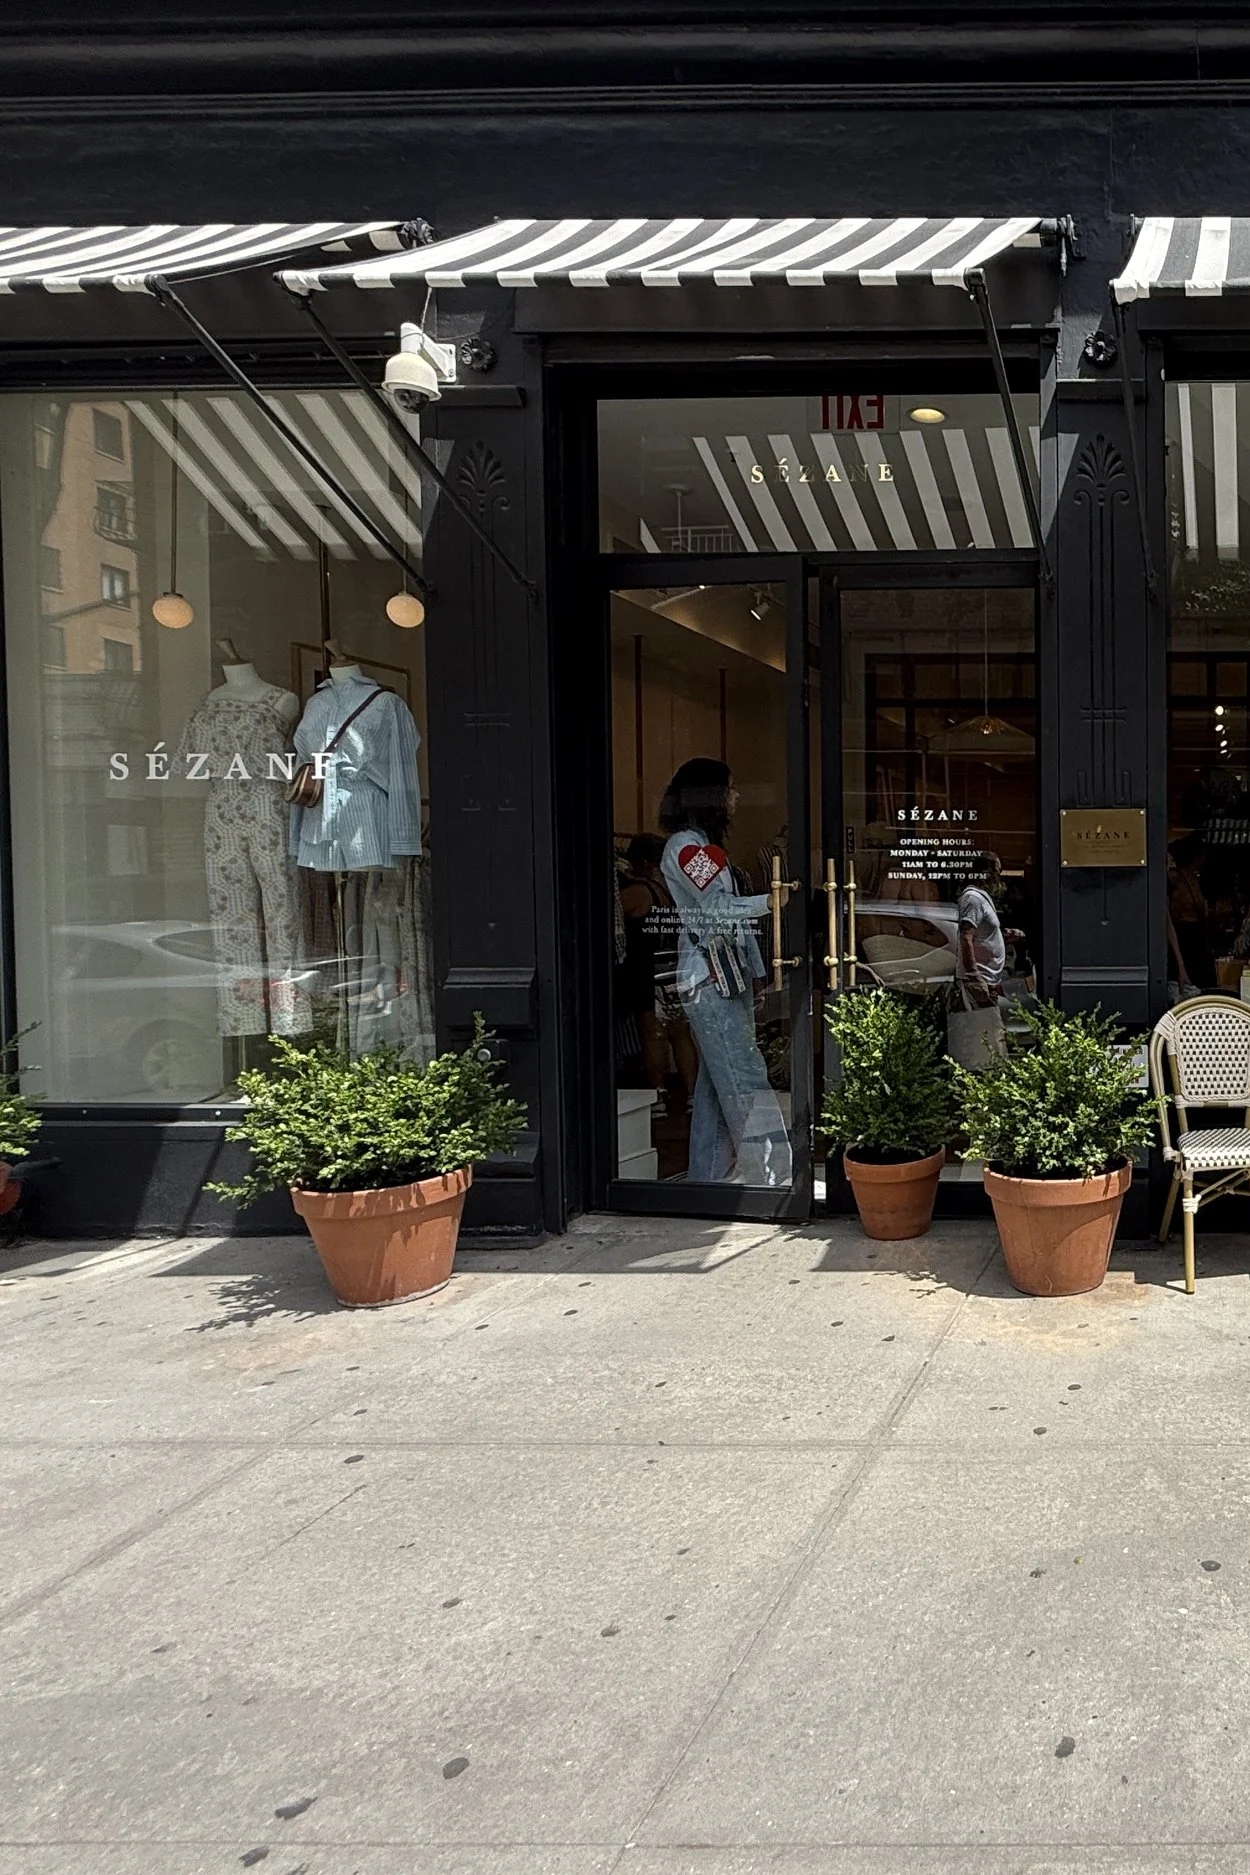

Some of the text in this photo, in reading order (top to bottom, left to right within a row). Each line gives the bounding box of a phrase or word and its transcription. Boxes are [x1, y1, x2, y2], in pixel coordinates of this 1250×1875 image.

[751, 457, 894, 483] SÉZANE
[109, 741, 336, 780] SÉZANE
[897, 806, 978, 821] SÉZANE
[900, 838, 976, 847] OPENING HOURS:
[890, 849, 930, 857] MONDAY
[937, 849, 984, 857] SATURDAY
[888, 872, 987, 881] SUNDAY, 12PM TO 6PM
[651, 905, 670, 914] Paris
[645, 915, 659, 924] and
[642, 925, 659, 934] with
[660, 925, 674, 934] fast
